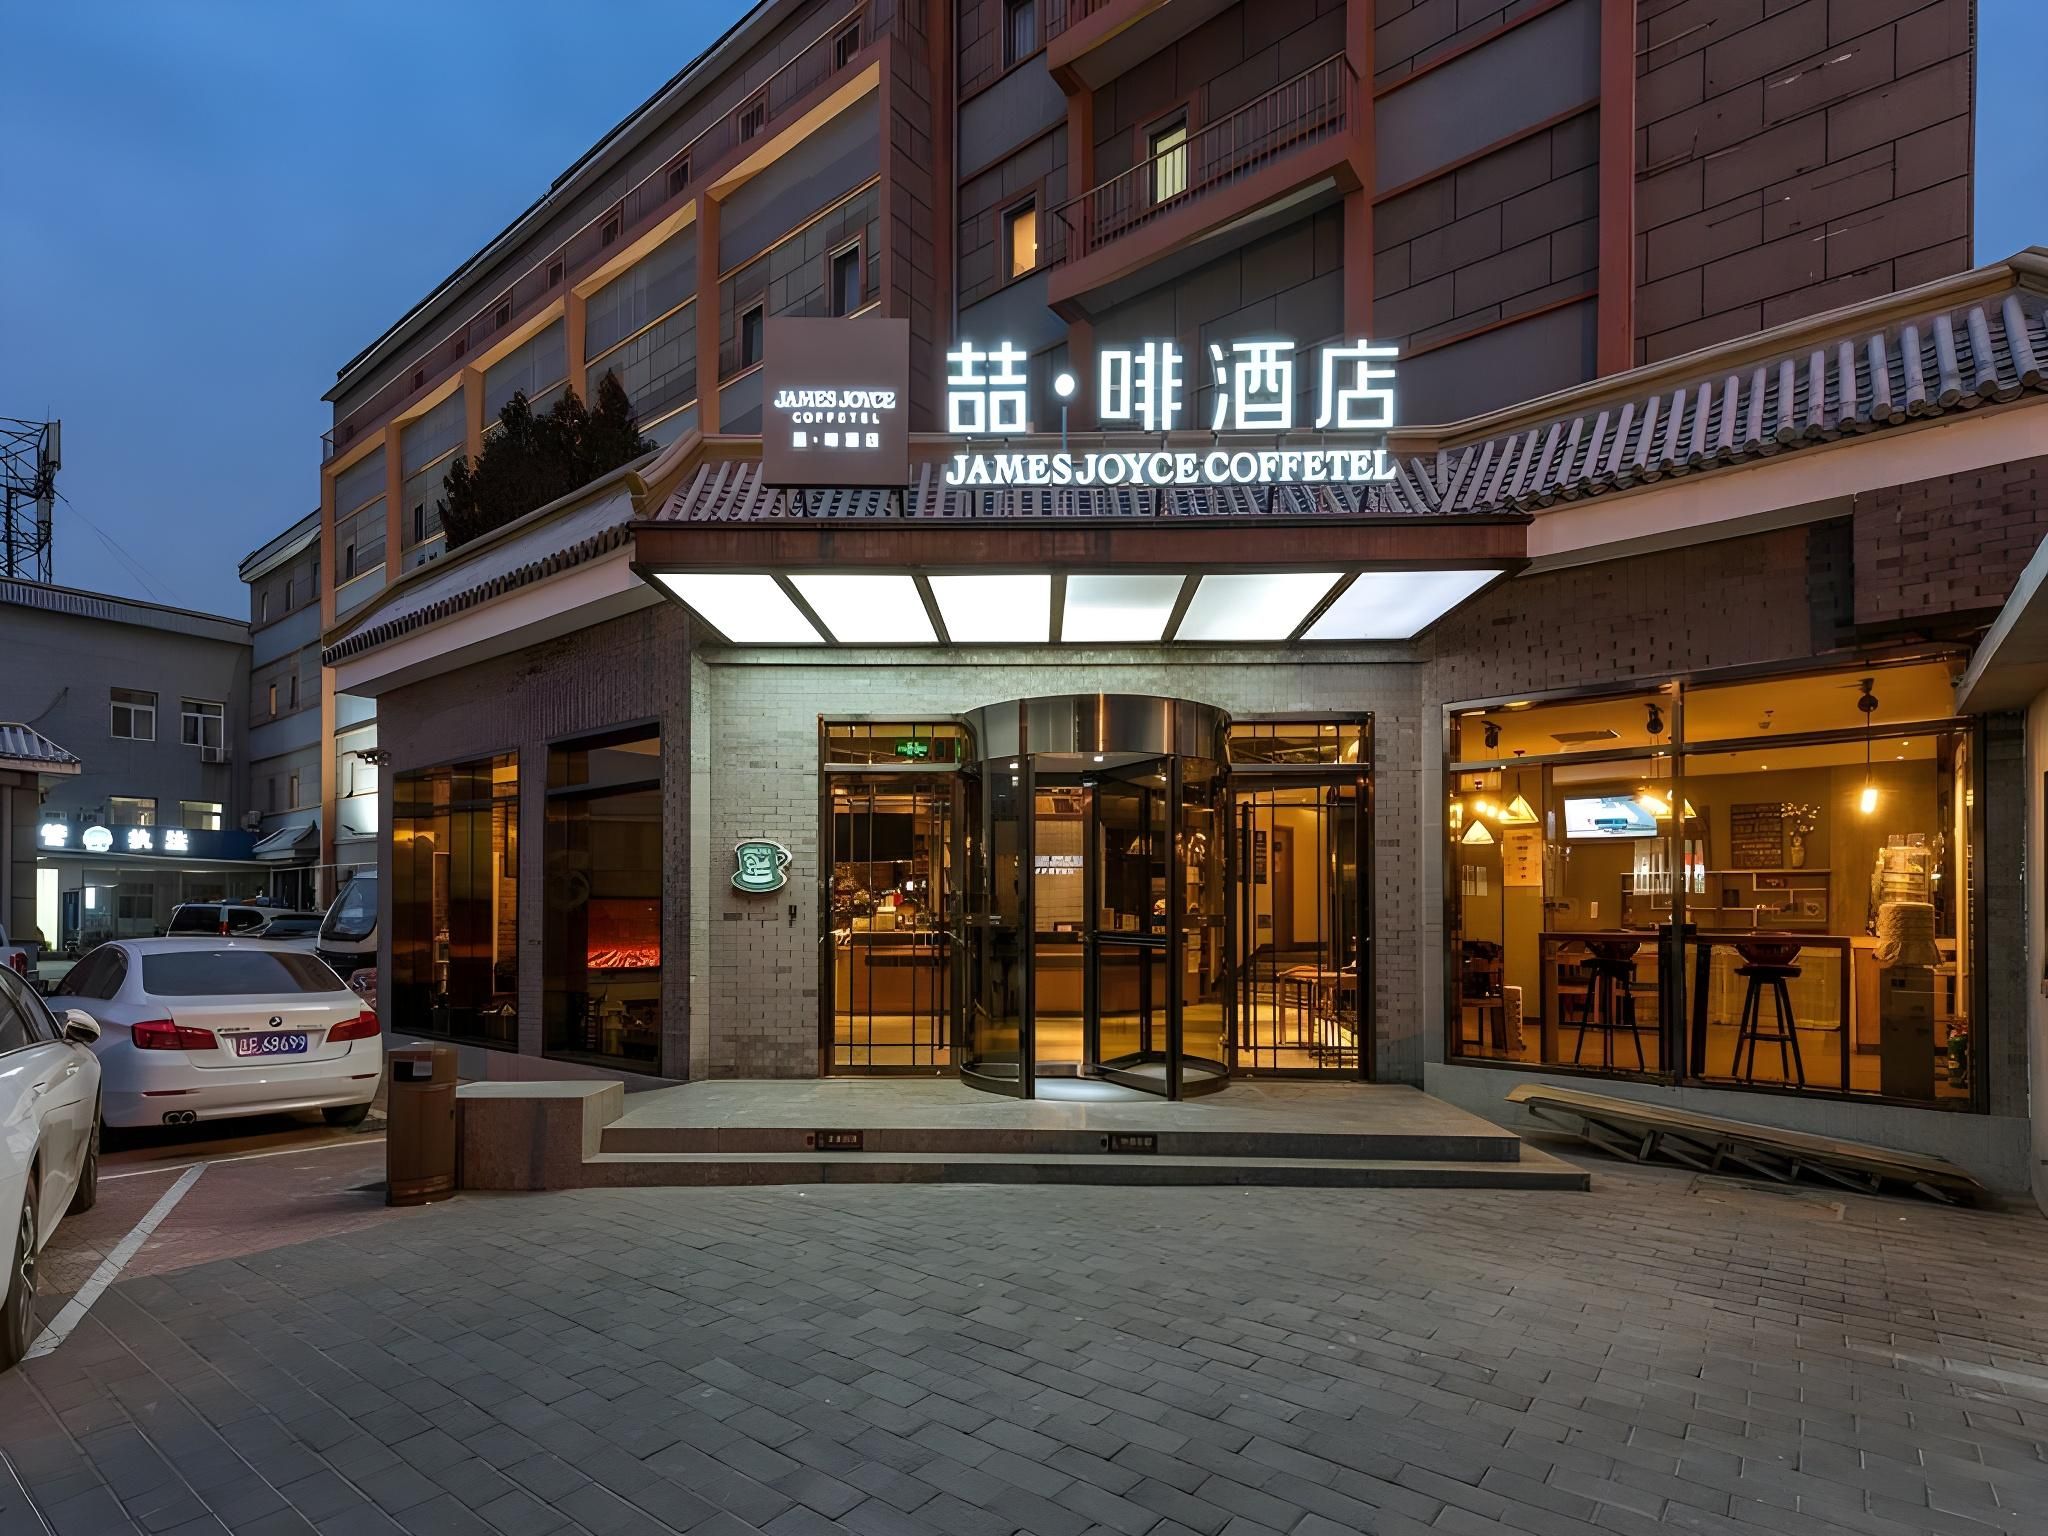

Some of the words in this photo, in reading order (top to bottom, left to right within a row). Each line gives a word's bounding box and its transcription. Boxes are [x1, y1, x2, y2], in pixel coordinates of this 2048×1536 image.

[774, 390, 837, 408] JAMES
[838, 390, 896, 409] JOYCE
[946, 453, 1072, 486] JAMES
[1075, 452, 1200, 485] JOYCE
[1204, 449, 1397, 483] COFFETEL
